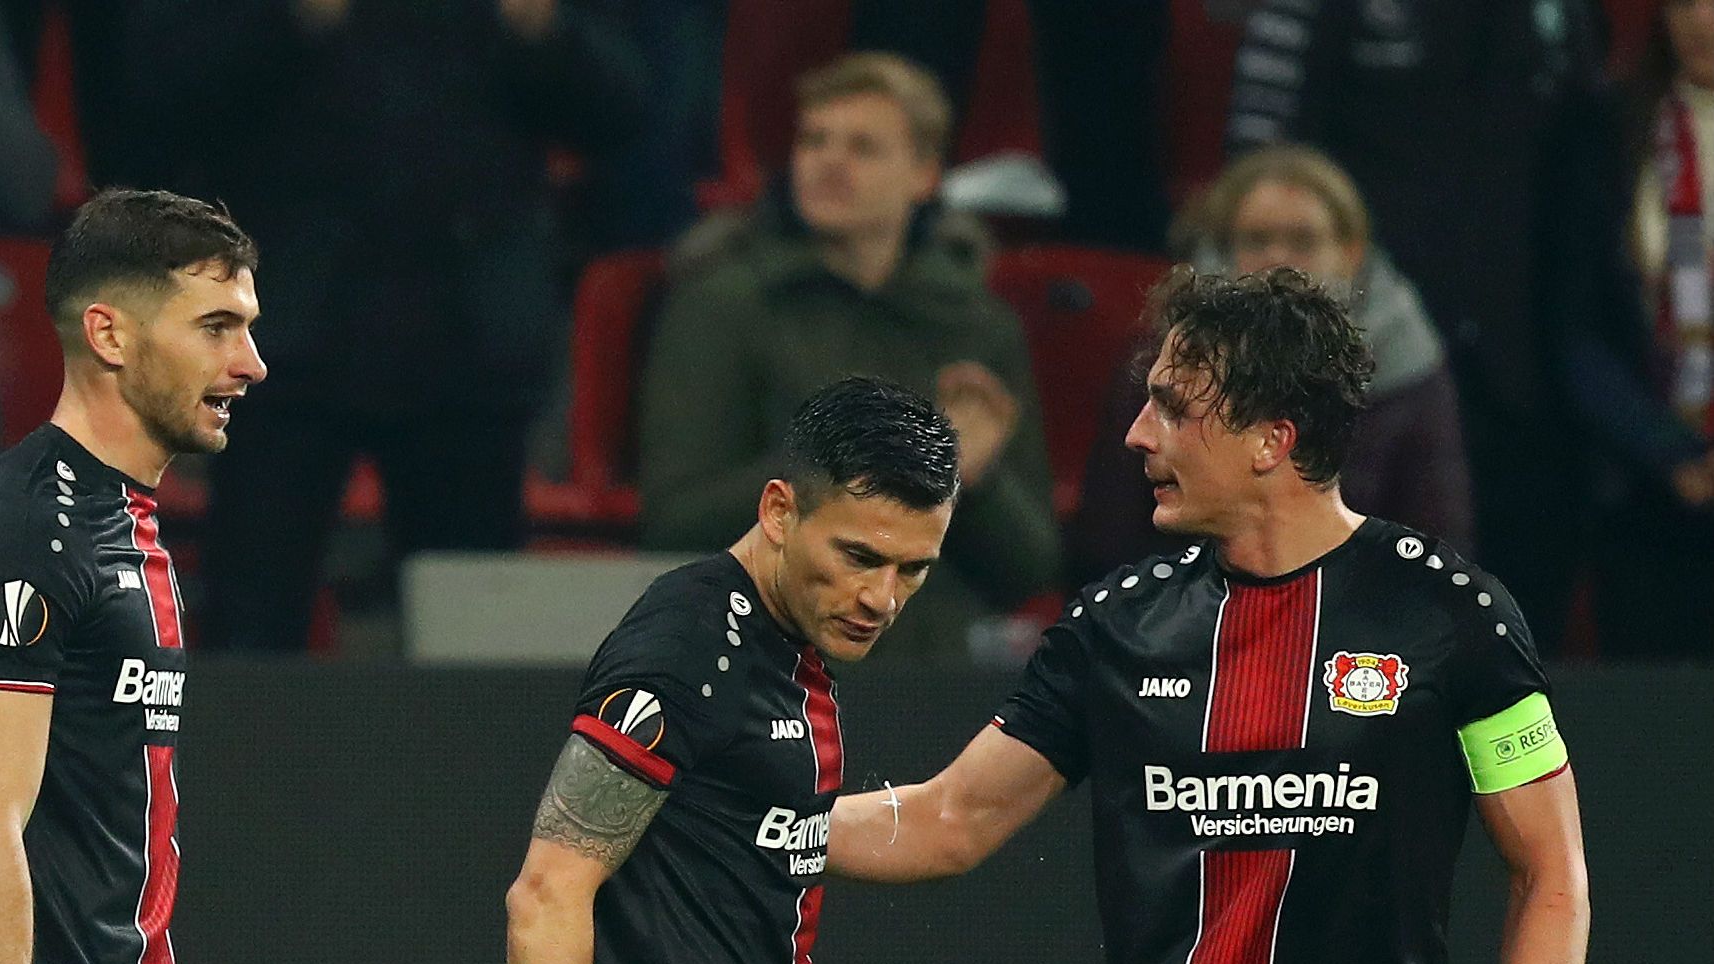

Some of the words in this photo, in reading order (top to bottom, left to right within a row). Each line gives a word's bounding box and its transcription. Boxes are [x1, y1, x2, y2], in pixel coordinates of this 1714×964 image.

[1138, 677, 1192, 698] JAKO
[1144, 762, 1380, 812] Barmenia
[1190, 813, 1355, 837] Versicherungen
